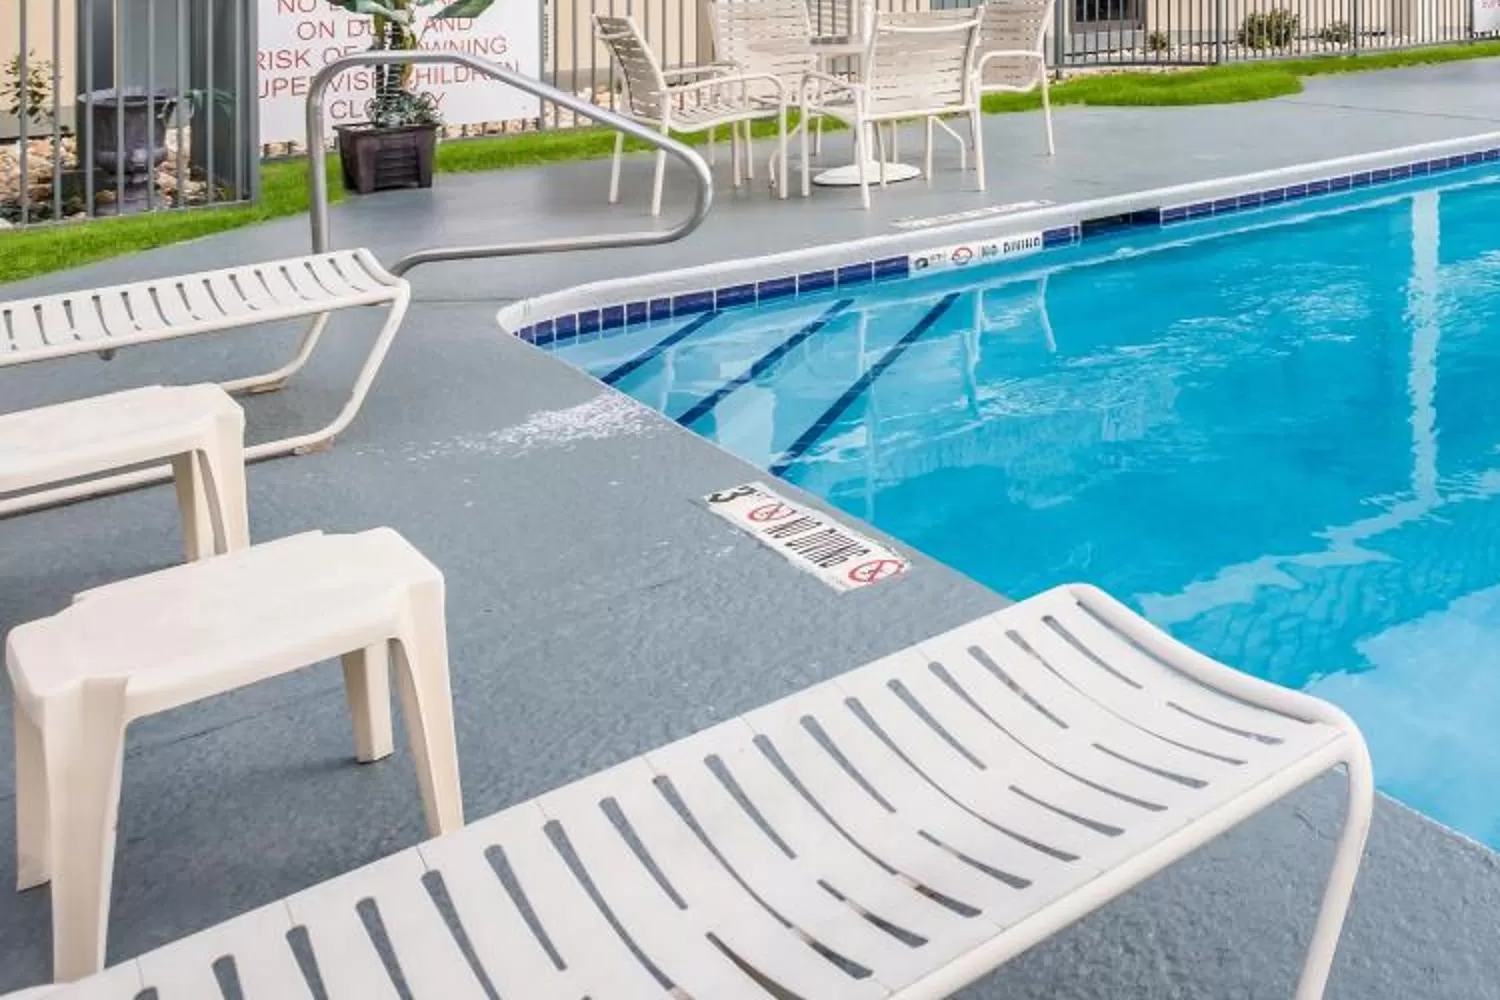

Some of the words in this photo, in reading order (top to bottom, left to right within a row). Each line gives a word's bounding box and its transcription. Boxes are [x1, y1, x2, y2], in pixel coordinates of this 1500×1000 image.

[297, 20, 335, 41] ON
[424, 16, 473, 32] AND
[256, 47, 311, 72] RISK
[784, 527, 871, 568] DIVING
